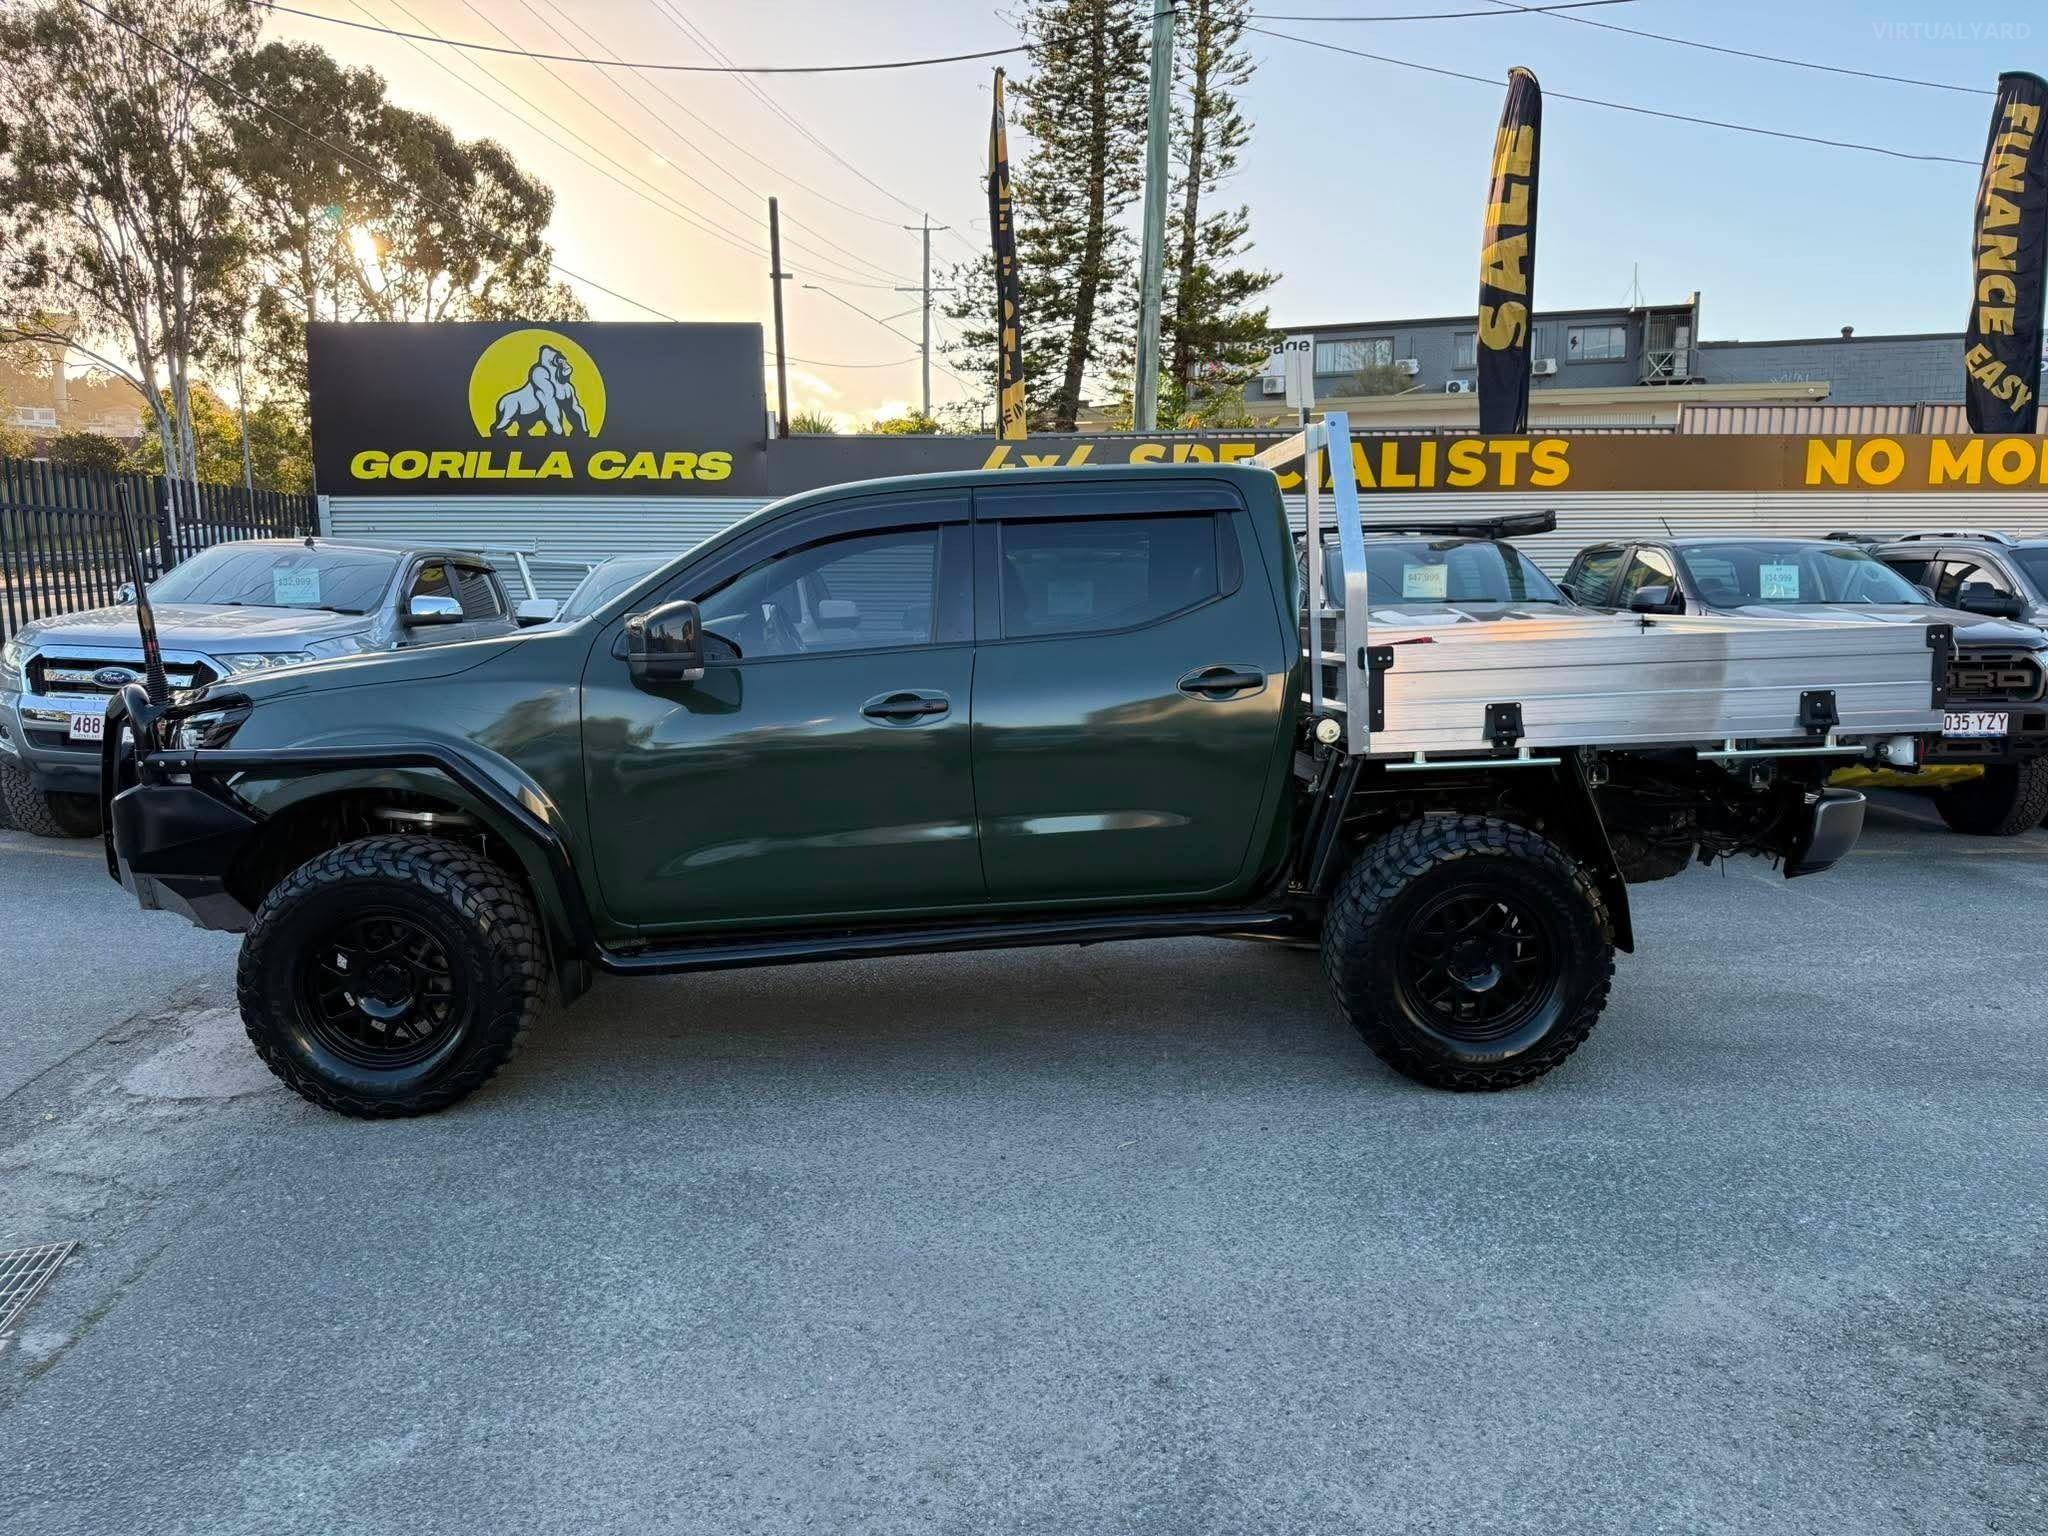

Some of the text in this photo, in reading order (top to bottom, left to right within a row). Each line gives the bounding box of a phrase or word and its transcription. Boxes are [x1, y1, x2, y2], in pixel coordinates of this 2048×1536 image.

[1479, 124, 1534, 351] SALE
[1977, 102, 2040, 336] FINANCE
[1964, 342, 2032, 413] EASY
[350, 451, 733, 481] GORILLA CARS
[1129, 438, 1570, 489] SPEALISTS
[1805, 438, 2048, 485] NO MO
[100, 671, 125, 683] Ford
[73, 716, 101, 733] 488
